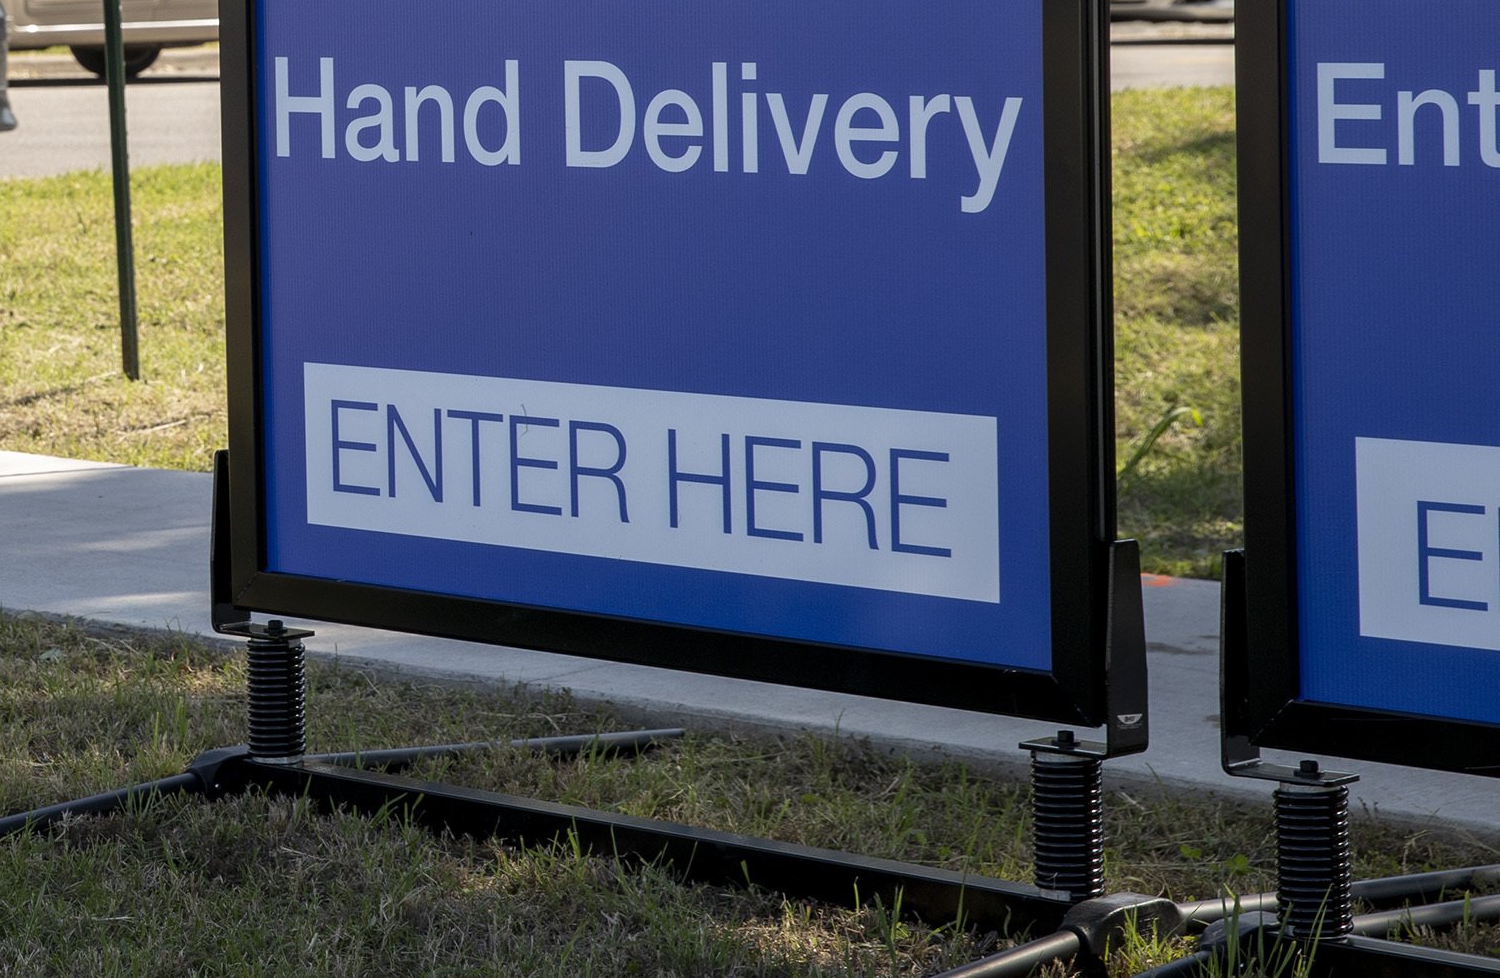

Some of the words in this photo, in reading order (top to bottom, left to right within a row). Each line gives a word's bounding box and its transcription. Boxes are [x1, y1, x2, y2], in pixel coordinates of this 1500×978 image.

[274, 57, 521, 167] Hand
[563, 60, 1023, 214] Delivery
[330, 399, 630, 524] ENTER
[667, 428, 952, 558] HERE
